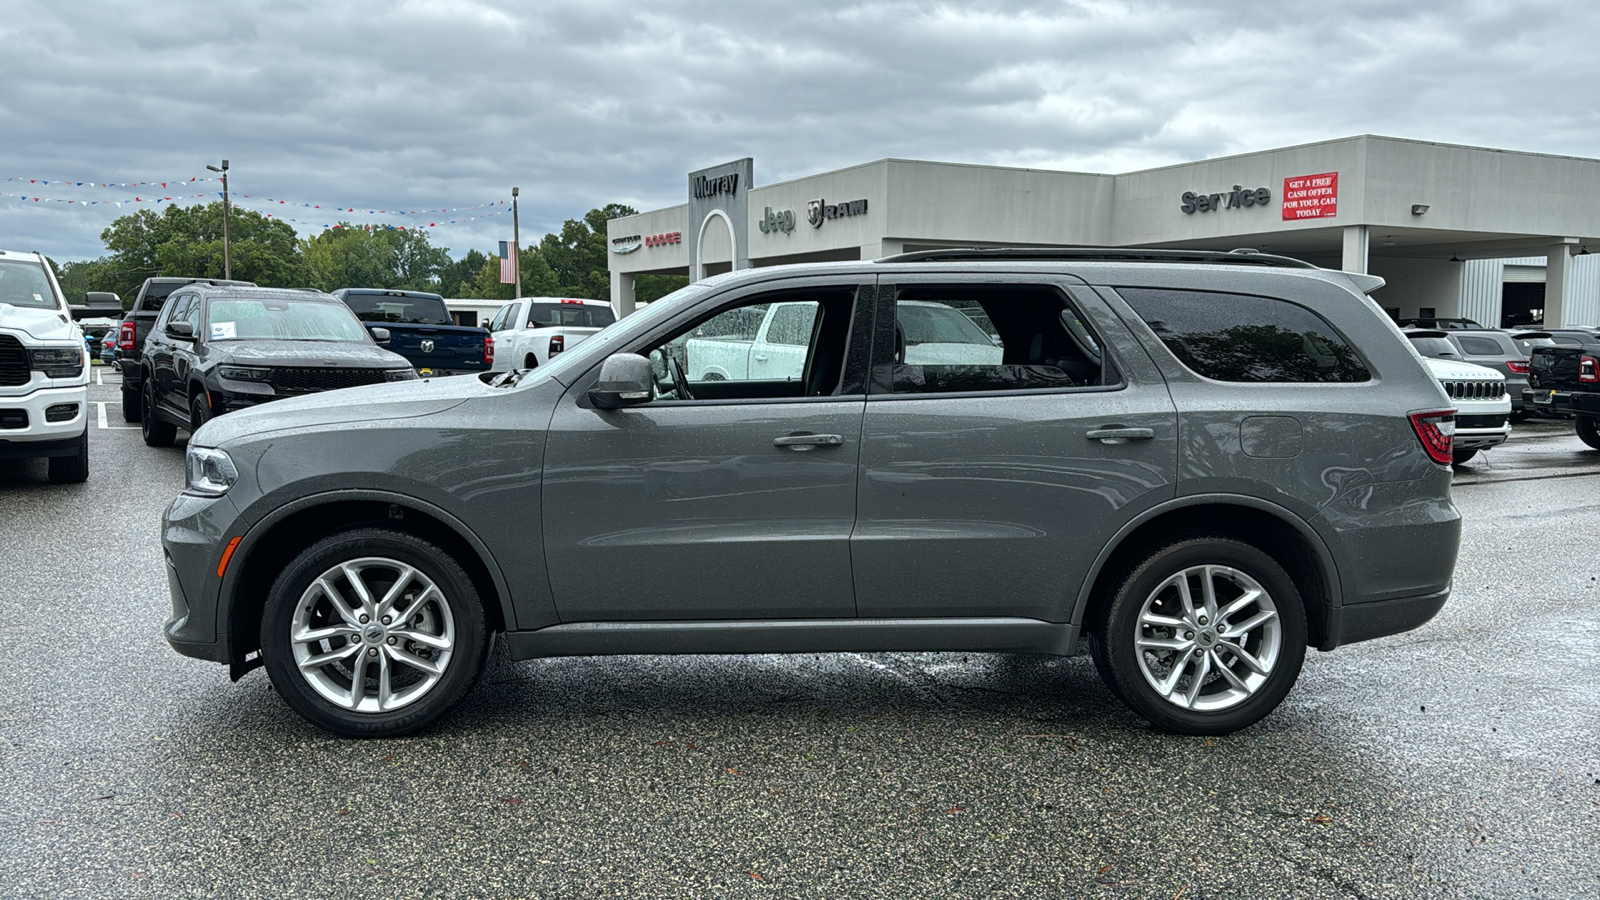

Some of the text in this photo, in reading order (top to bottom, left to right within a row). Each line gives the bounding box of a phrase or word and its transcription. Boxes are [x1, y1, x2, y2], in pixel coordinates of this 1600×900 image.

[693, 173, 738, 199] Murray
[1289, 177, 1332, 188] GET A FREE
[1181, 185, 1271, 214] Service
[1287, 187, 1333, 198] CASH OFFER
[823, 199, 868, 219] RAM
[1283, 197, 1337, 209] FOR YOUR CAR
[759, 206, 796, 235] Jeep
[1295, 208, 1322, 217] TODAY
[645, 231, 681, 248] DODGE
